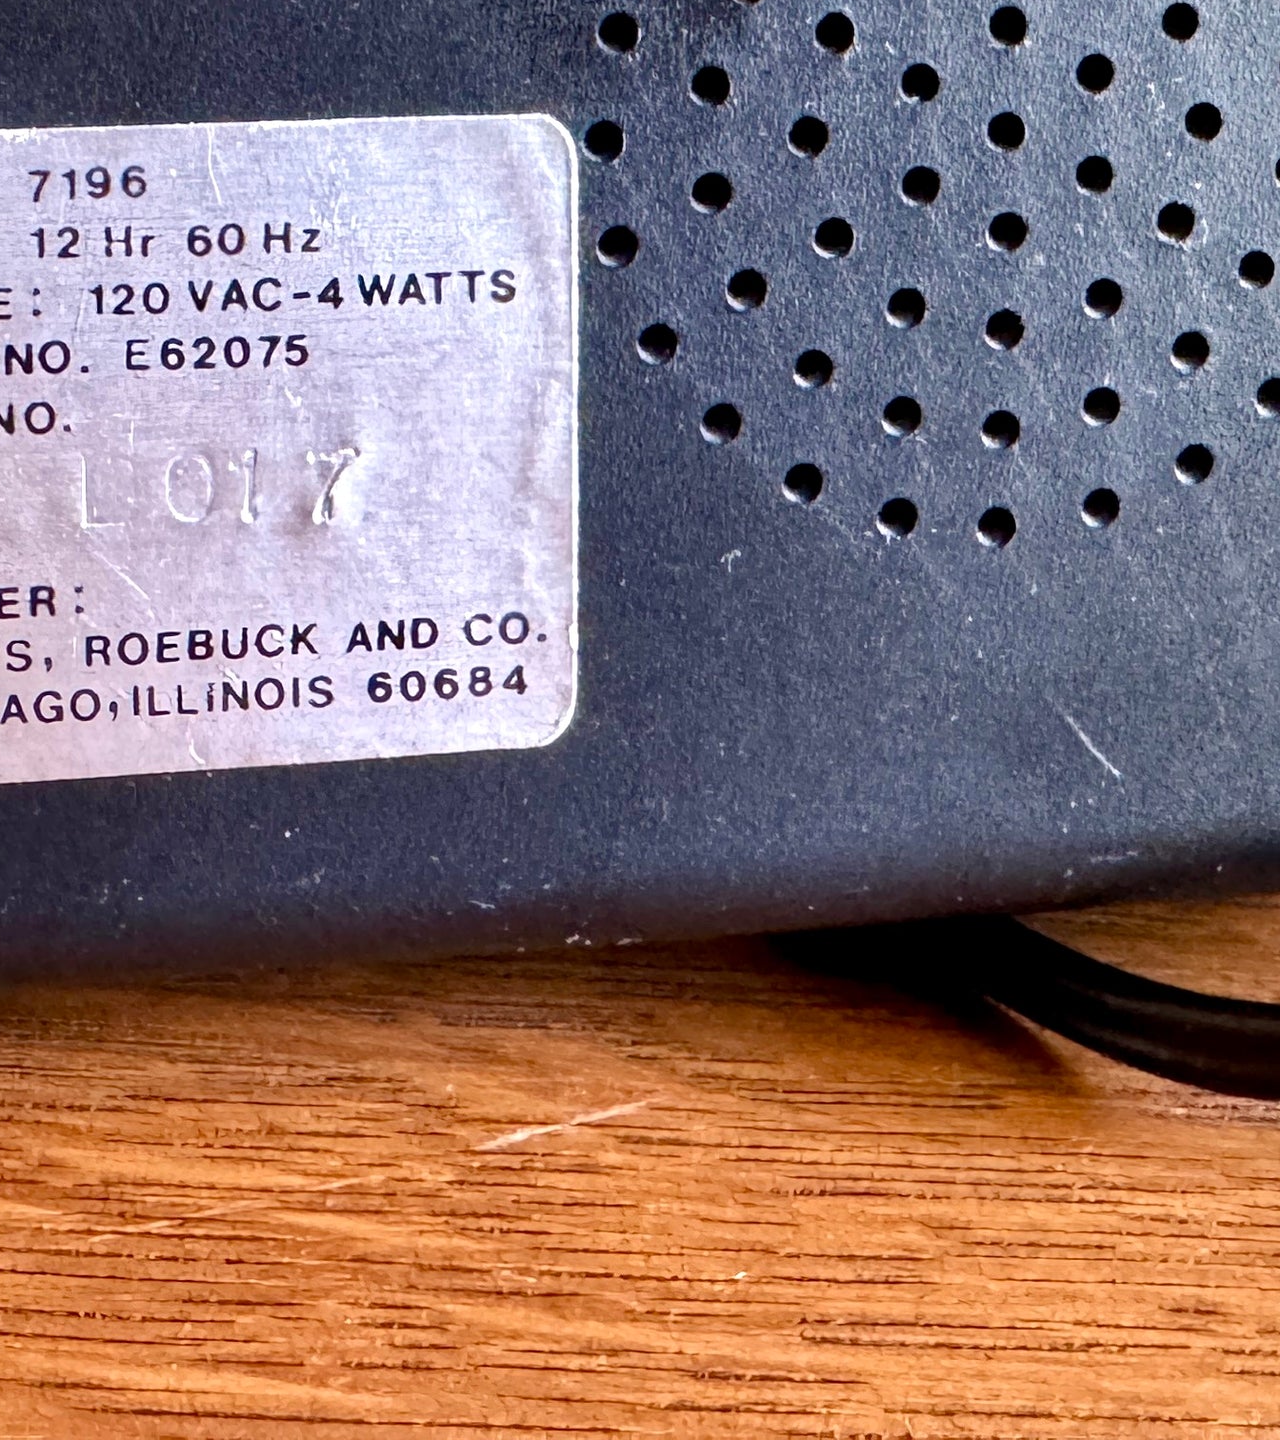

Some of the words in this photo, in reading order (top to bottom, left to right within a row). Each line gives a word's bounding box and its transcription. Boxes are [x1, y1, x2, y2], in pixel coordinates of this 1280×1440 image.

[27, 165, 147, 203] 7196
[30, 226, 81, 259] 12
[103, 225, 156, 258] Hr
[186, 222, 246, 258] 60
[262, 221, 321, 255] Hz
[88, 282, 170, 316] 120
[357, 269, 517, 307] WATTS
[4, 340, 90, 376] NO.
[125, 334, 310, 371] E62075
[85, 623, 318, 668] ROEBUCK
[345, 617, 439, 654] AND
[461, 611, 547, 647] CO.
[366, 664, 528, 703] 60684
